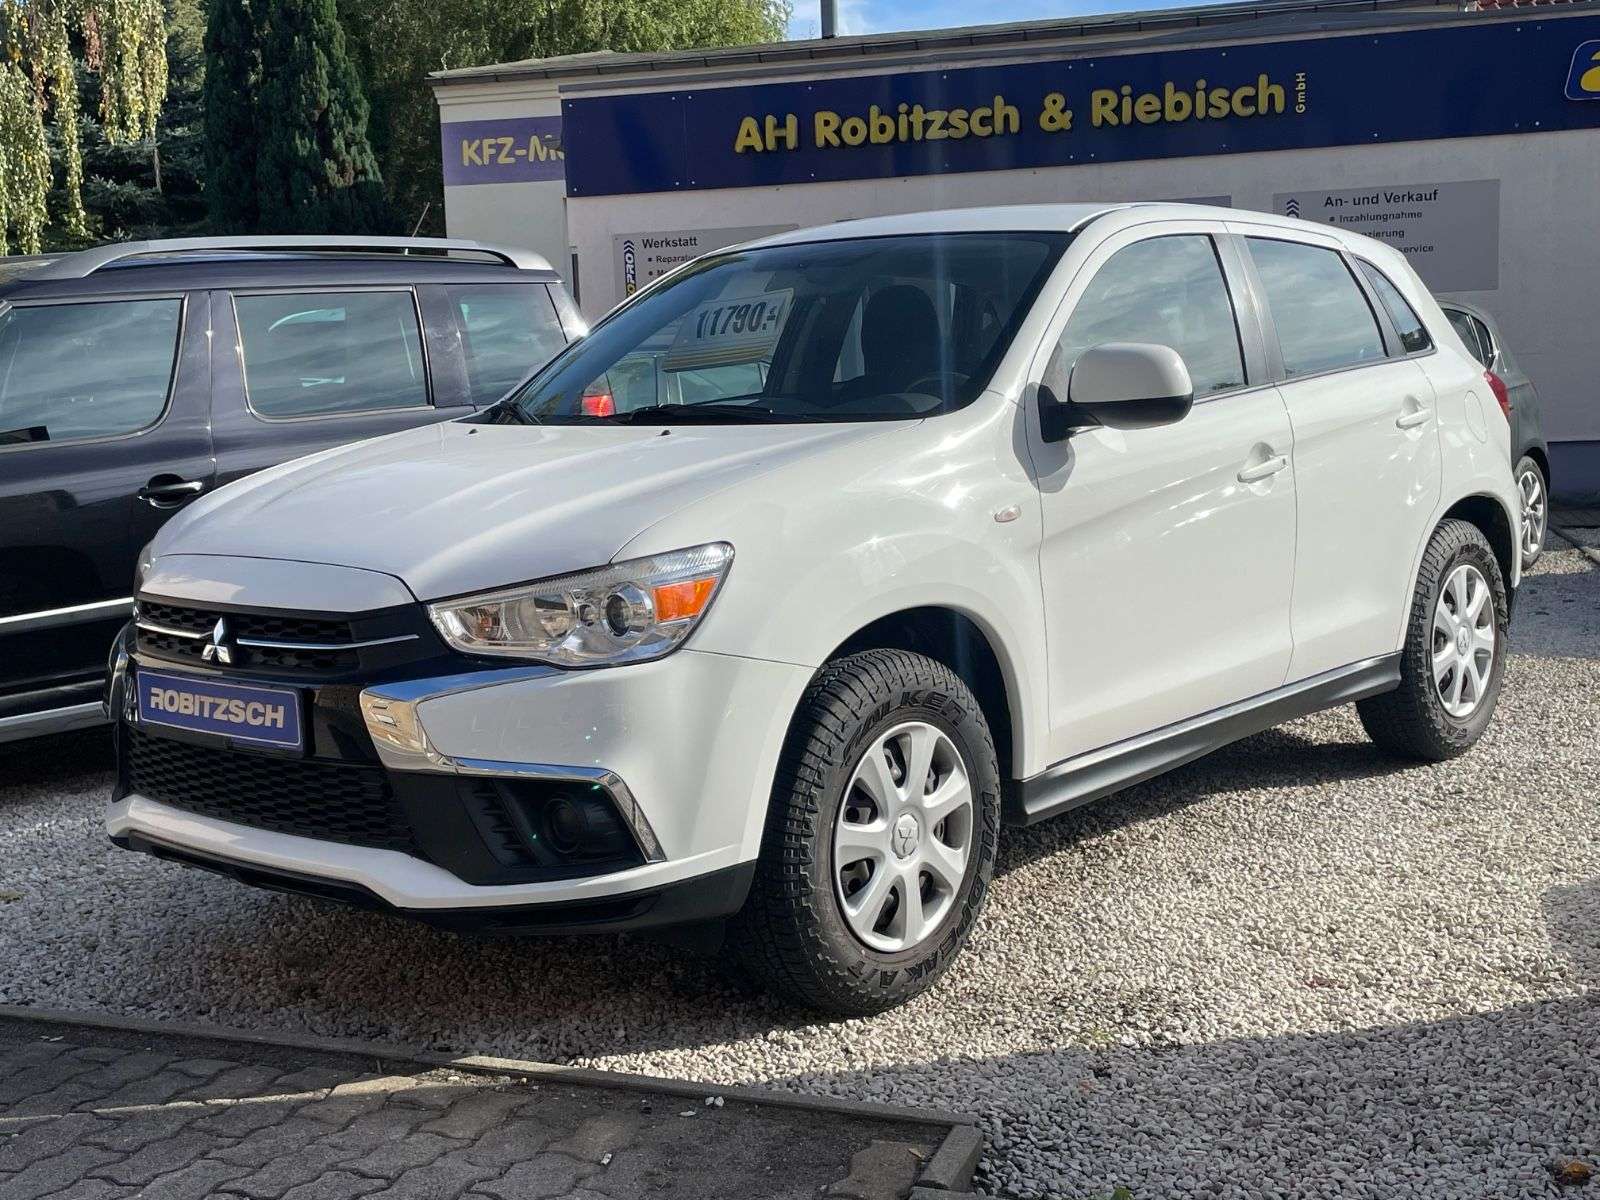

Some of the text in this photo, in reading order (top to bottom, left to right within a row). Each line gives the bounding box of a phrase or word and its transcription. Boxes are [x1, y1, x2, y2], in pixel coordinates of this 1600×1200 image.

[1295, 72, 1306, 113] GmbH
[735, 73, 1286, 154] AH Robitzsch & Riebisch
[462, 135, 565, 166] KFZ-M
[1324, 189, 1439, 207] An- und Verkauf
[1339, 210, 1423, 223] Inzahlungnahme
[641, 236, 699, 249] Werkstatt
[150, 687, 286, 729] ROBITZSCH
[904, 790, 998, 983] WILDPEAK
